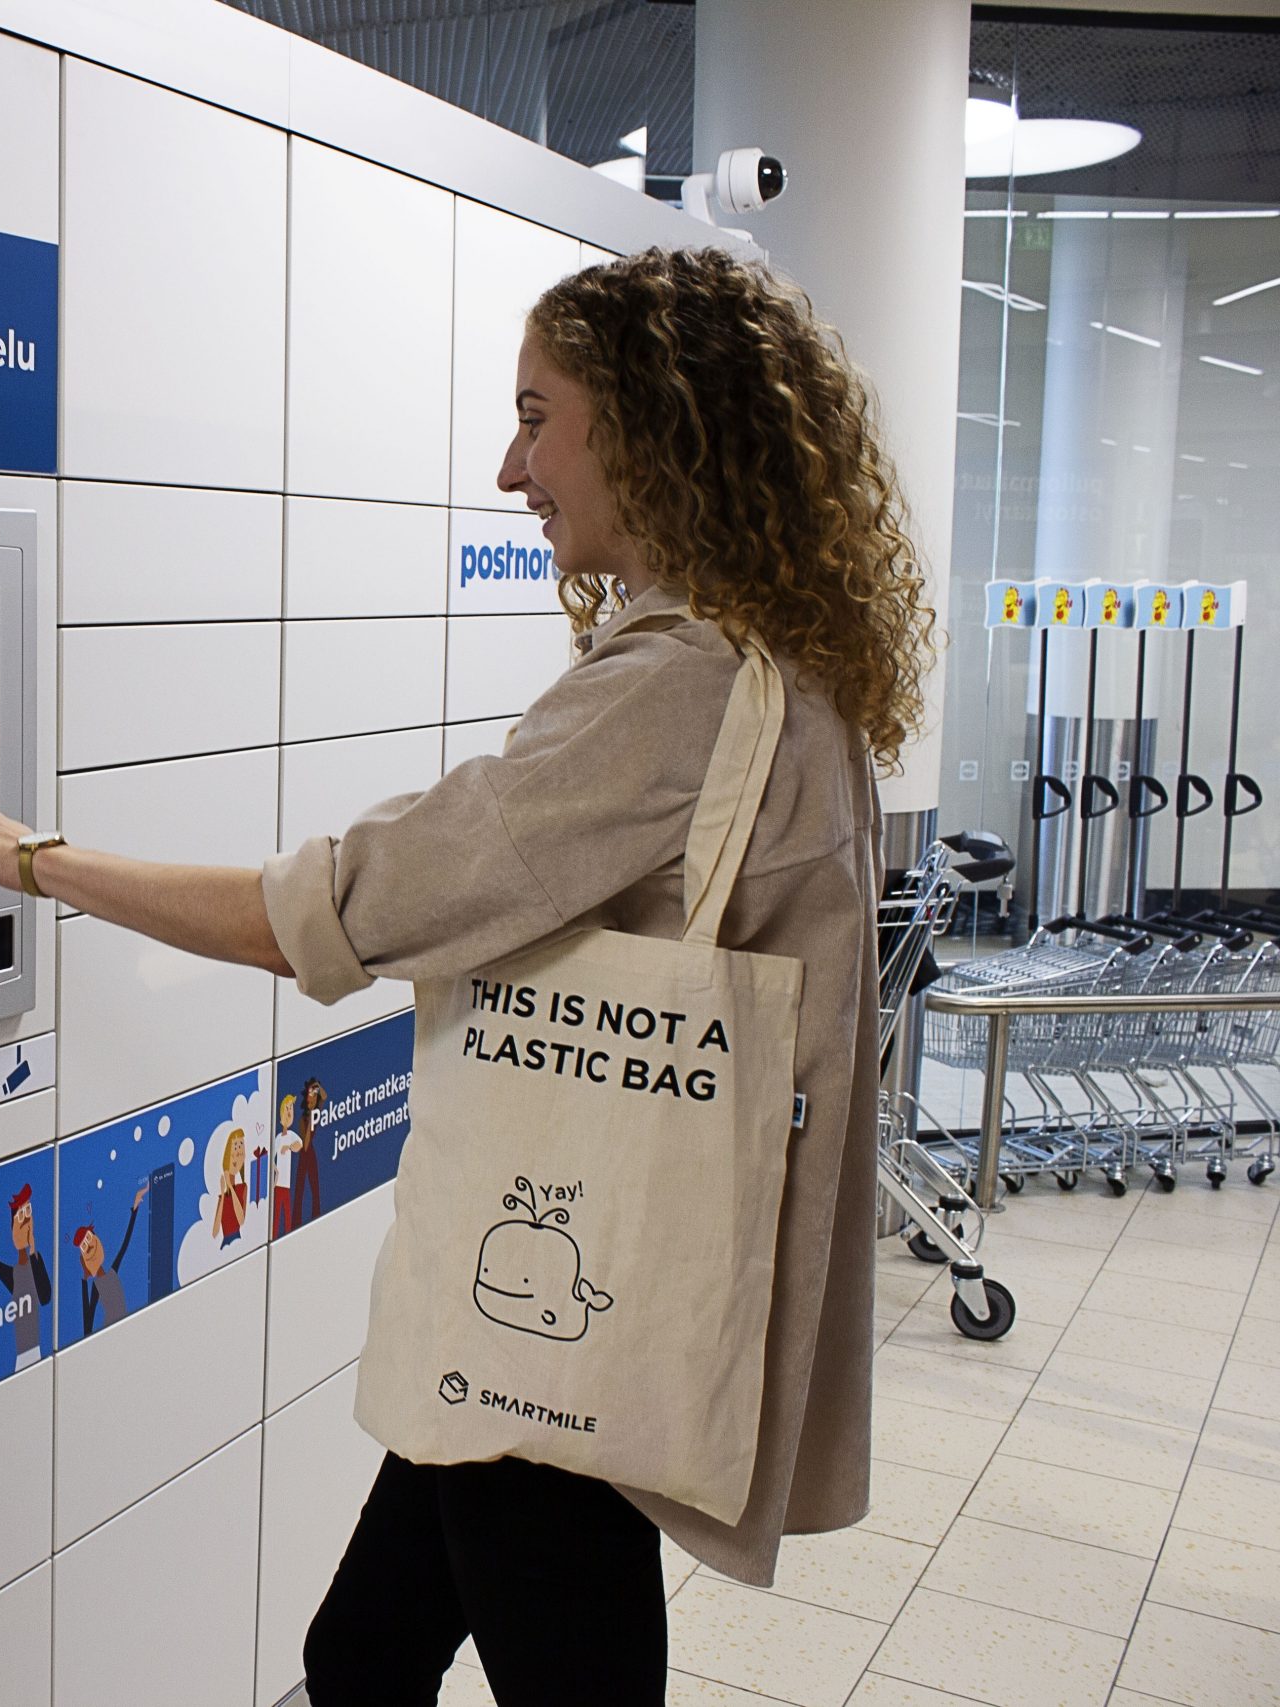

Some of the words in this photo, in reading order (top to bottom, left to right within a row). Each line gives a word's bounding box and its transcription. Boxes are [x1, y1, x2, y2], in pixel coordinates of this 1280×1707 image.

[460, 540, 560, 588] postnor
[471, 978, 536, 1018] THIS
[549, 991, 585, 1027] IS
[596, 1000, 686, 1045] NOT
[698, 1019, 730, 1053] A
[463, 1027, 610, 1084] PLASTIC
[621, 1058, 717, 1102] BAG
[311, 1090, 361, 1131] Paketit
[332, 1101, 410, 1160] jonottamat
[539, 1180, 585, 1203] Yay!
[479, 1389, 597, 1433] SMARTMILE
